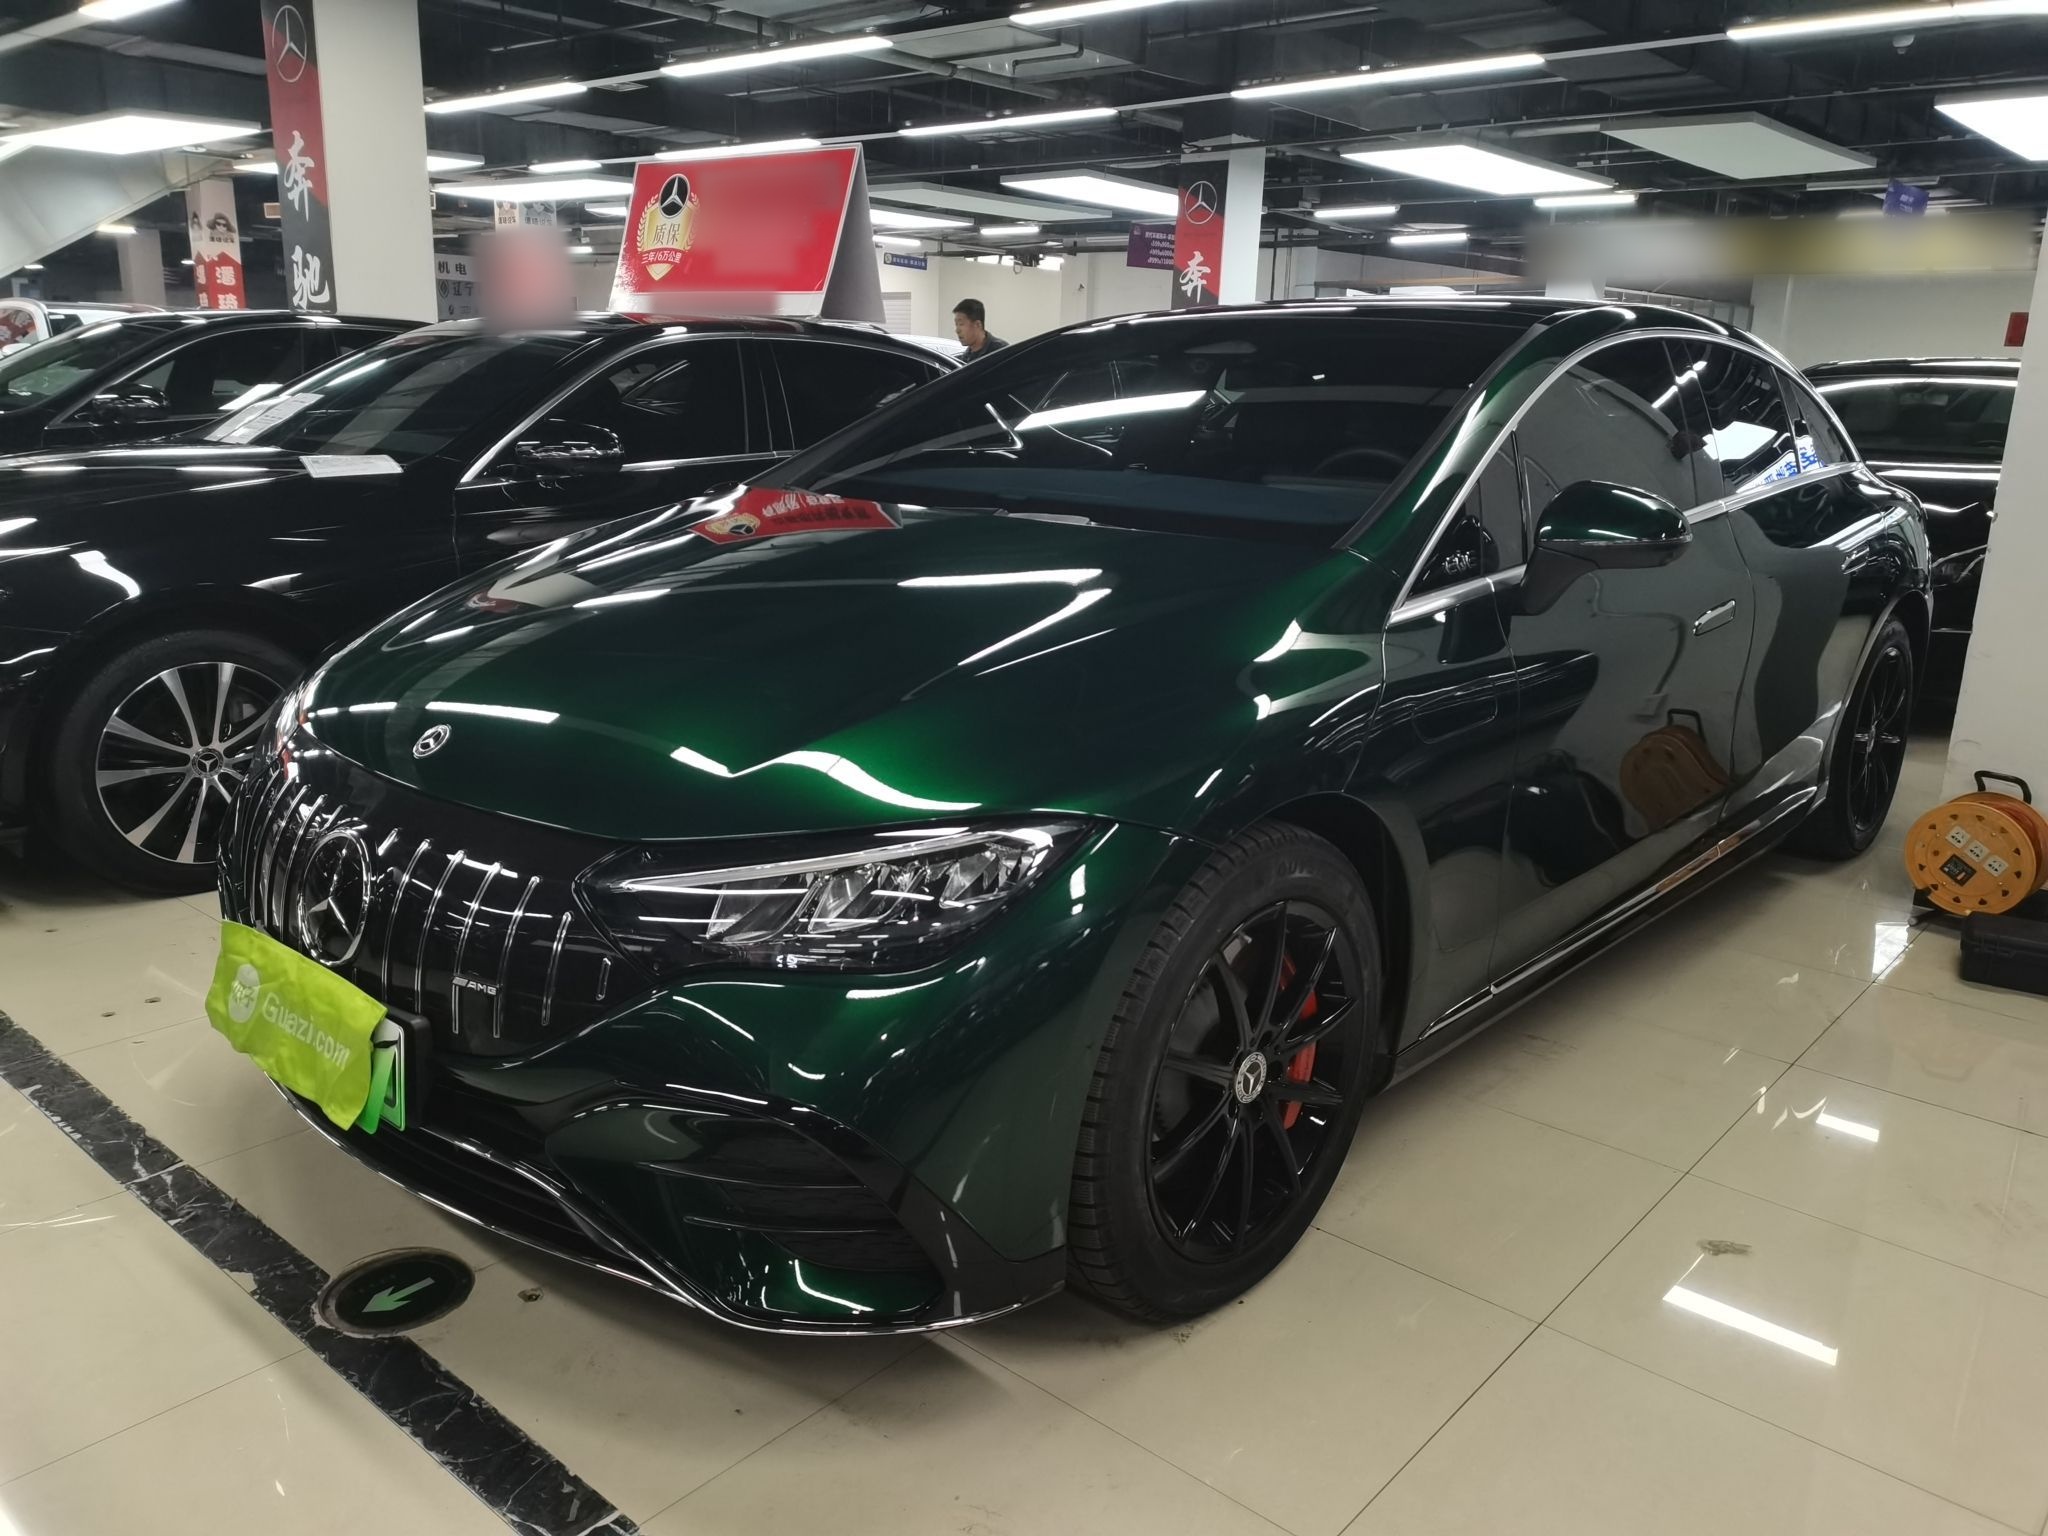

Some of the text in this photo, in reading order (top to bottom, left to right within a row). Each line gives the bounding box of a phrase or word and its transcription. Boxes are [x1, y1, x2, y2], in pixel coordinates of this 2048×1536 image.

[653, 223, 681, 246] 质保
[641, 250, 683, 265] 三年/6万公里
[467, 980, 497, 995] AMG
[262, 992, 350, 1071] Guazi.com
